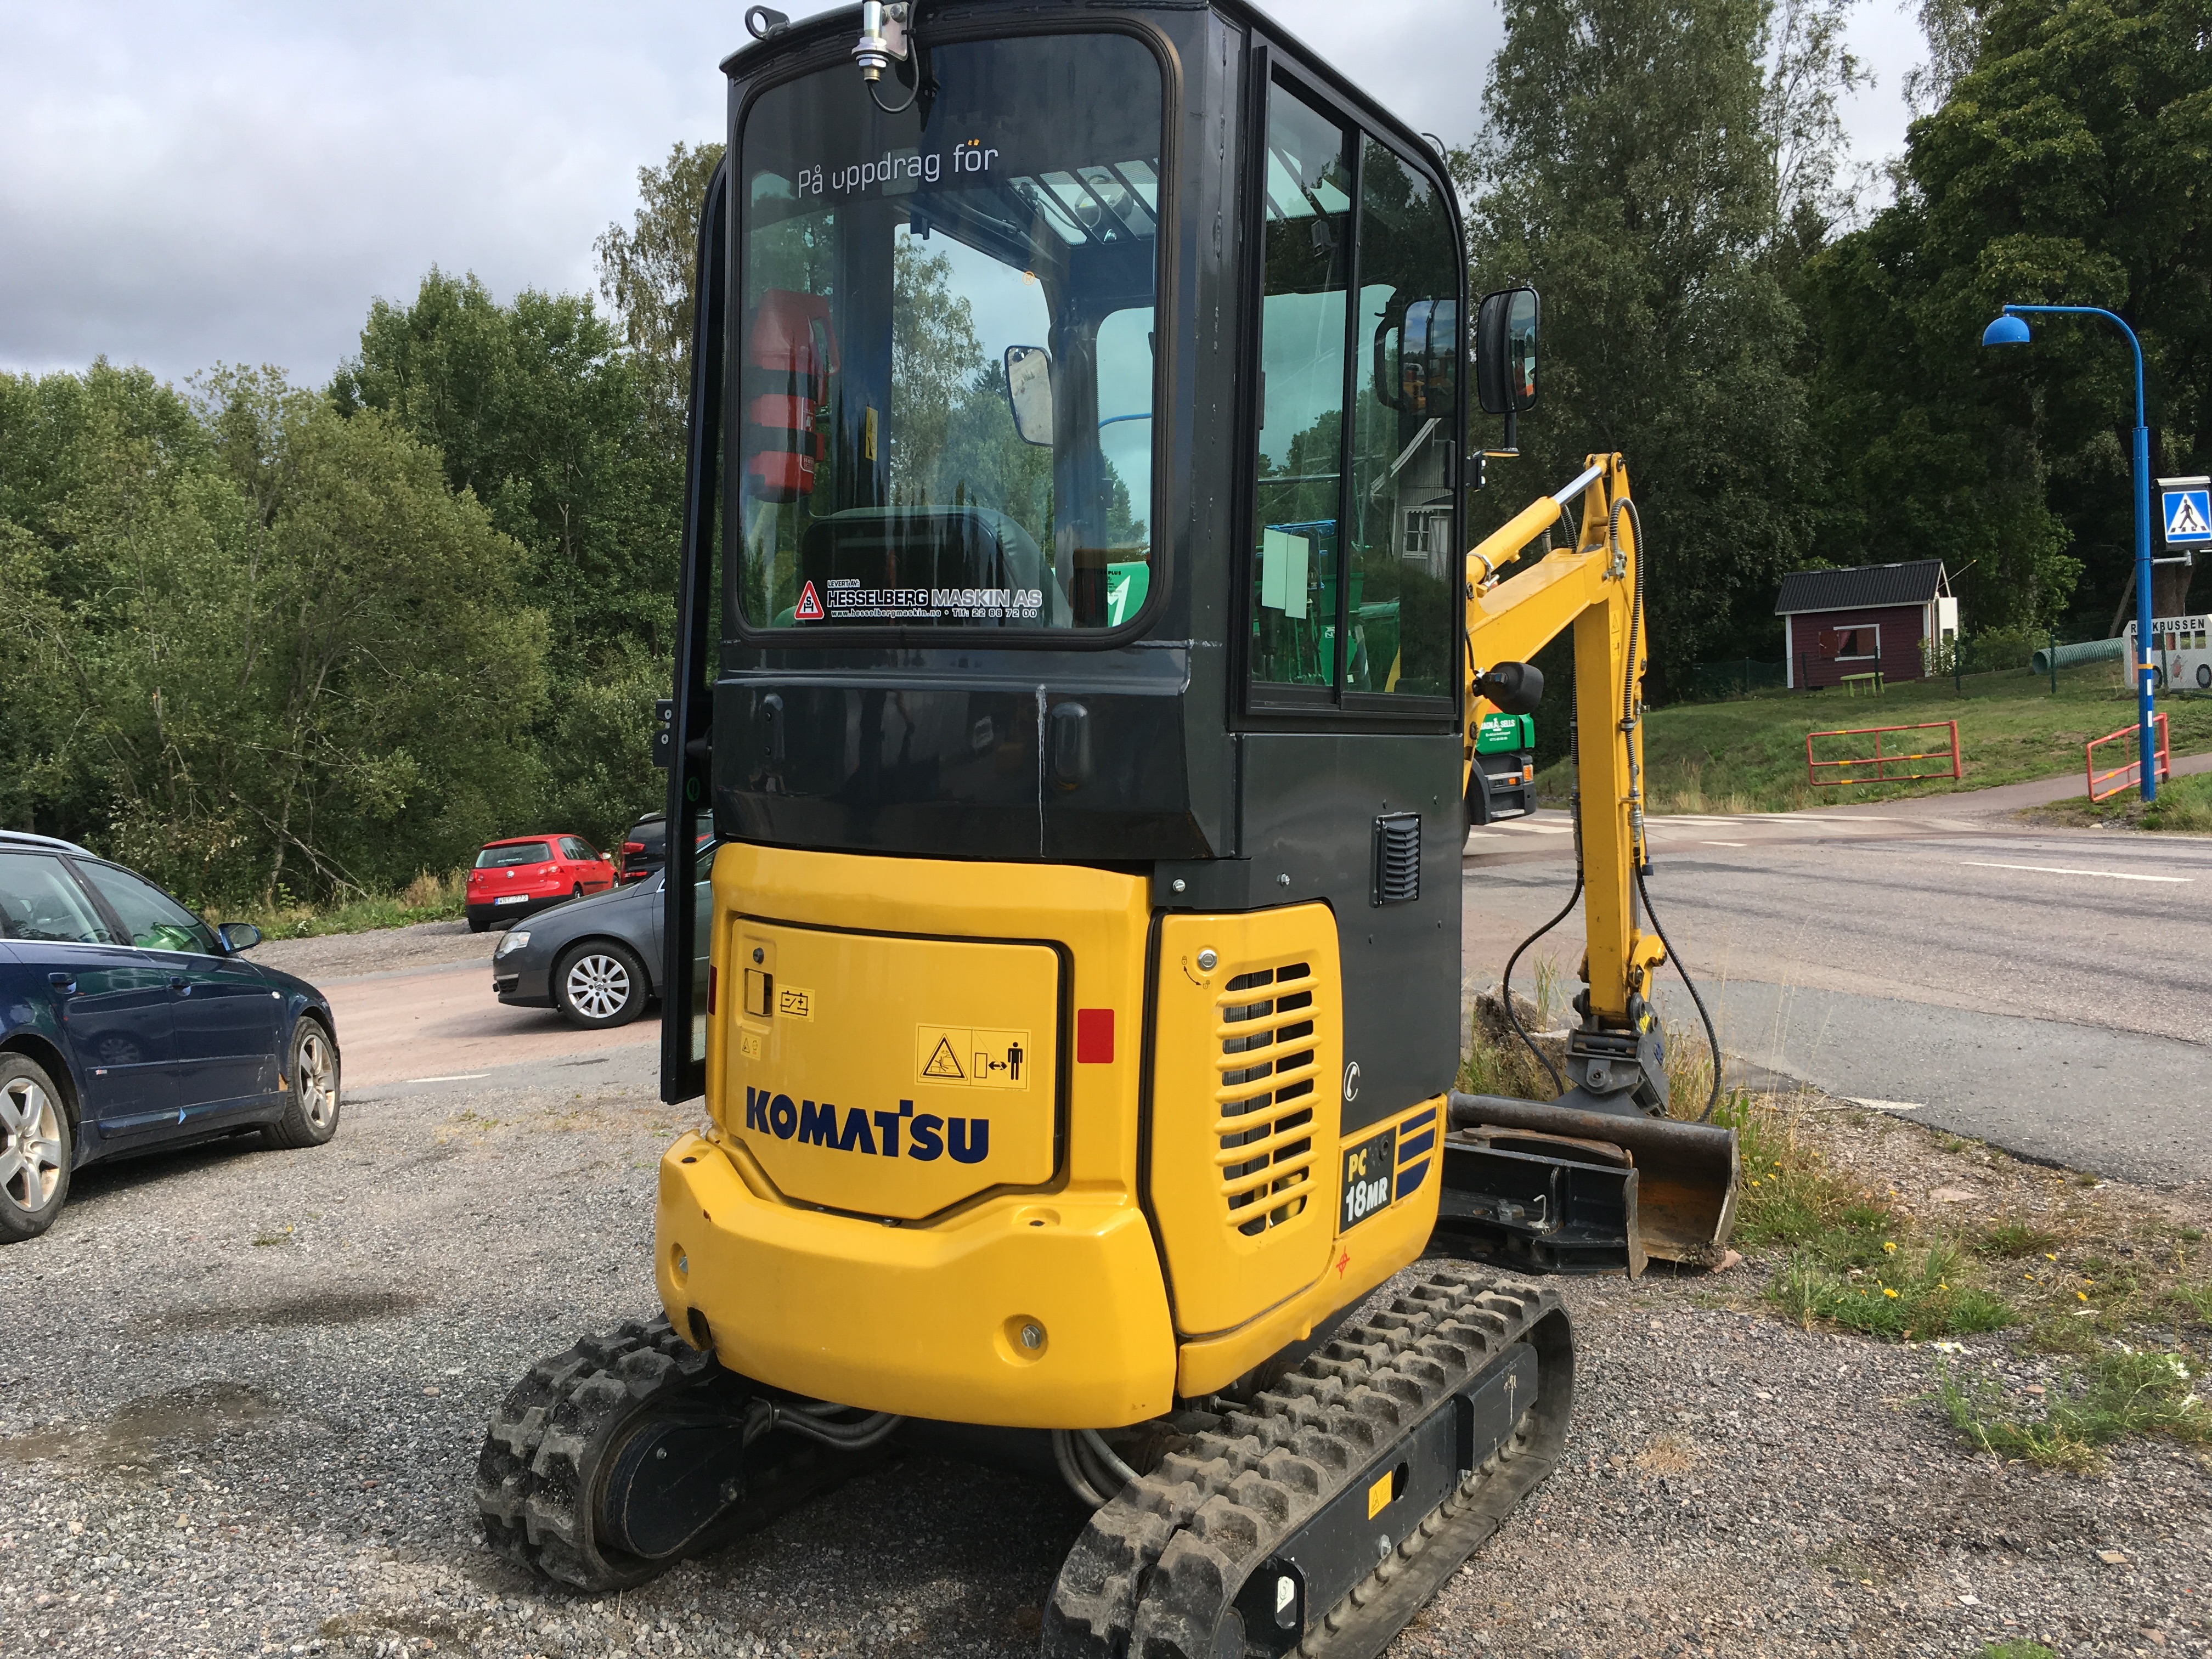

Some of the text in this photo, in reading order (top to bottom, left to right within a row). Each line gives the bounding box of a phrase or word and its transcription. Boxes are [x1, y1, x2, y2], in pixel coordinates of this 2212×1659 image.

[798, 138, 998, 199] På uppdrag för
[827, 579, 860, 588] LEVERT AV:
[827, 589, 1042, 607] HESSELBERG MASKIN AS
[831, 608, 1037, 618] www.hesselbergmaskin.no Tlf: 22 88 72 00
[2131, 618, 2204, 633] RKBUSSEN
[746, 1086, 989, 1164] KOMATSU
[1347, 1148, 1367, 1182] PC
[1346, 1176, 1388, 1222] 18MR
